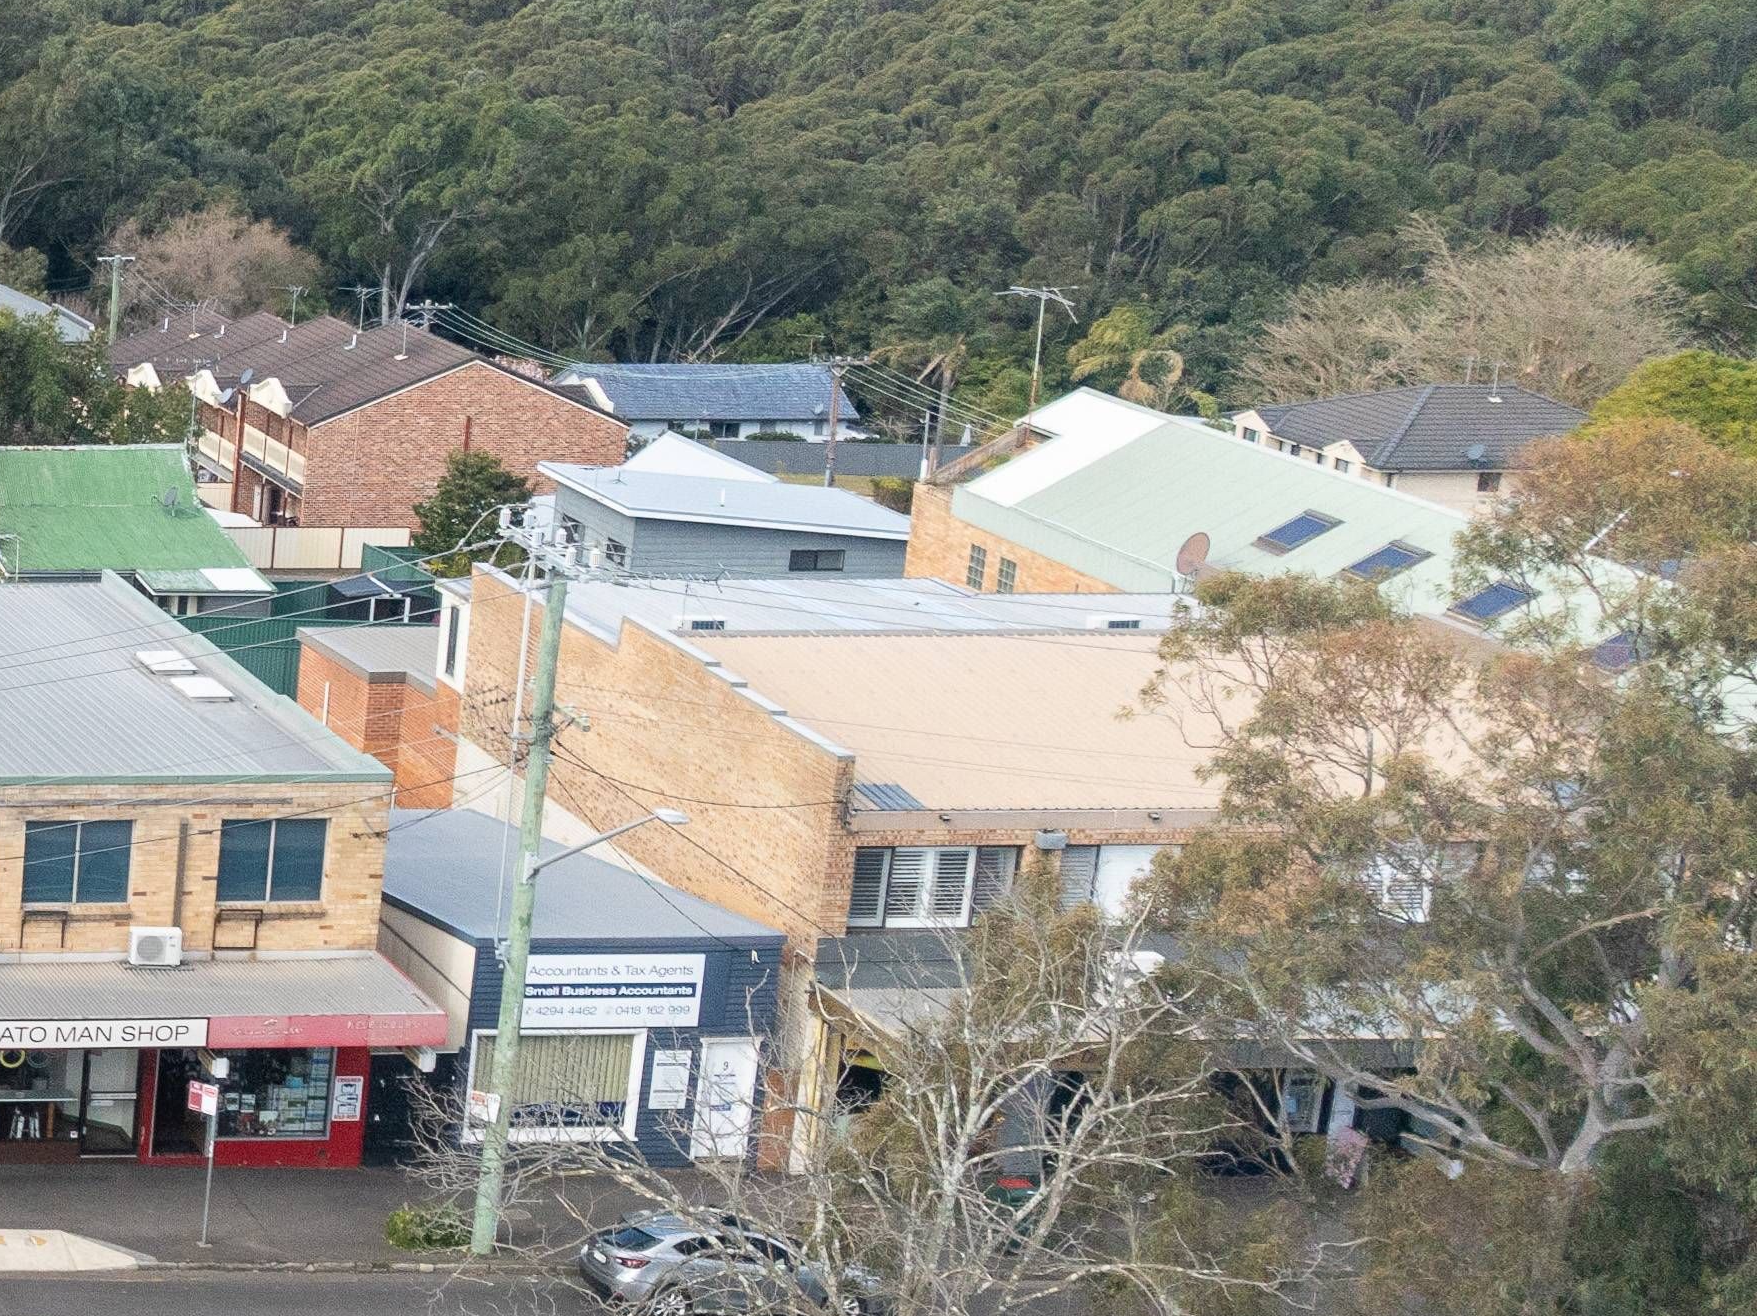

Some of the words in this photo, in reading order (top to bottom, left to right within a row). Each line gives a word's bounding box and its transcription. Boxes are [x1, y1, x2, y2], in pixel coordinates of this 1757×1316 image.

[529, 966, 608, 977] Accountants
[611, 966, 621, 976] &
[625, 965, 646, 976] Tax
[648, 965, 694, 978] Agents
[525, 986, 560, 997] Small
[562, 986, 617, 996] Business
[618, 986, 693, 996] Accountants
[535, 1006, 564, 1016] 4294
[55, 1025, 113, 1042] MAN
[120, 1024, 190, 1042] SHOP
